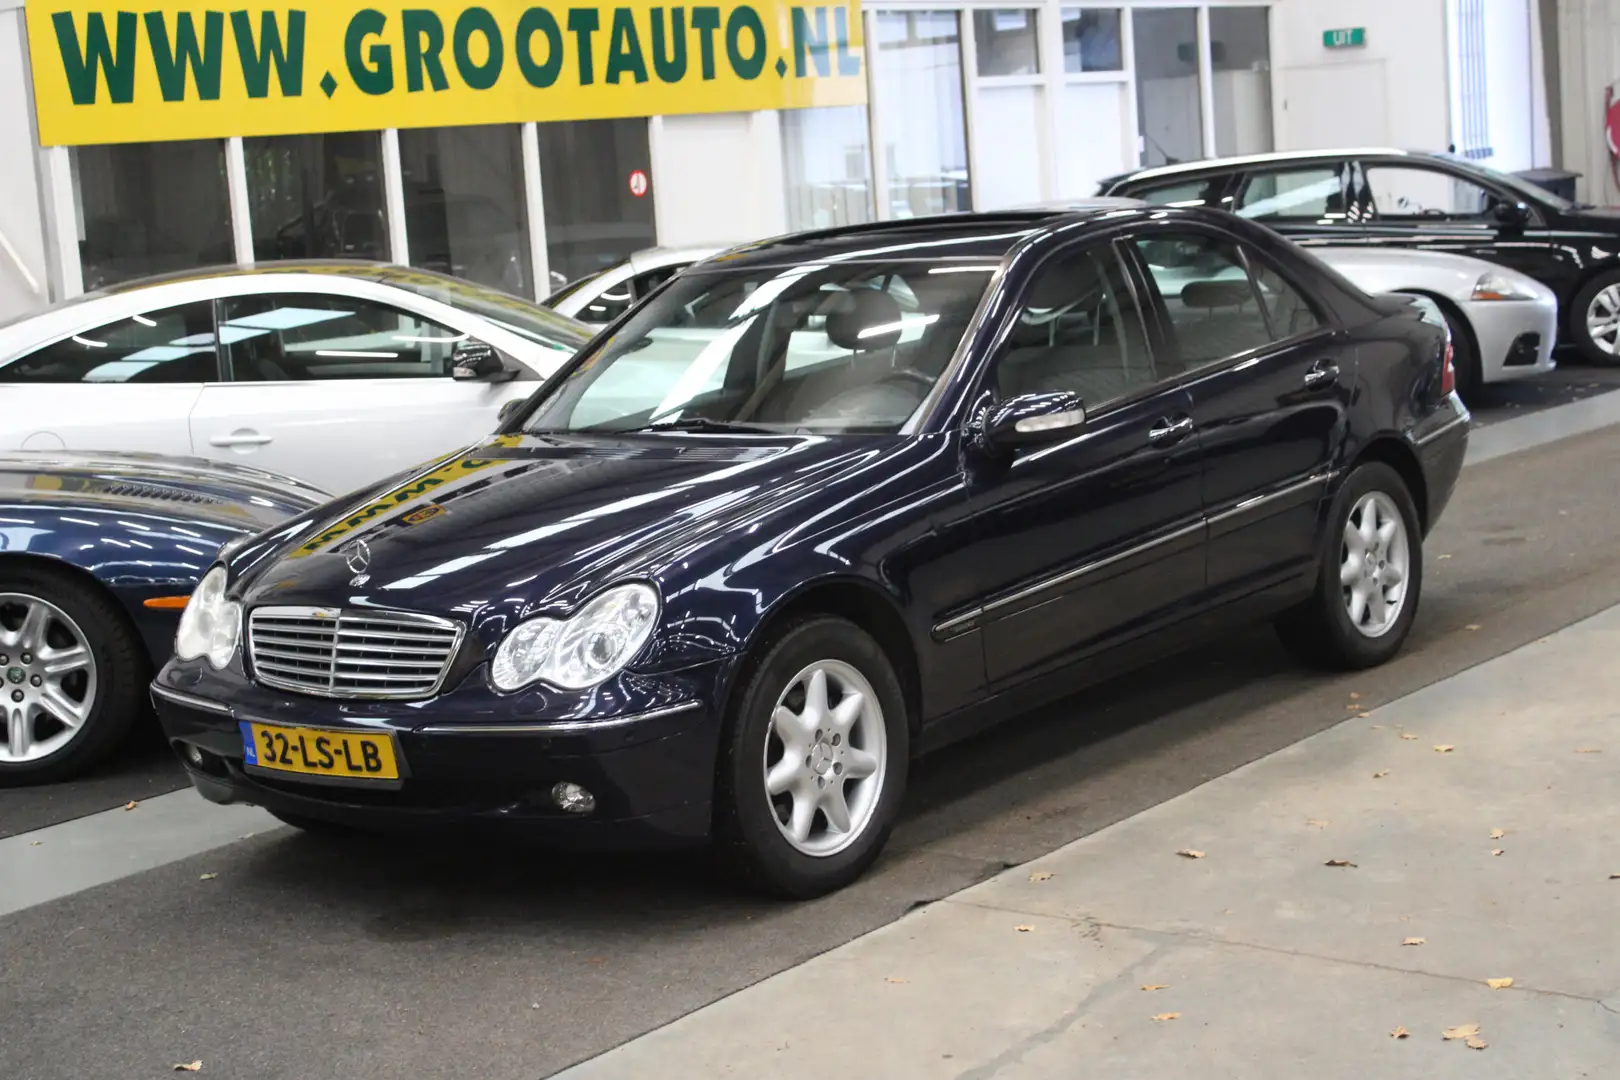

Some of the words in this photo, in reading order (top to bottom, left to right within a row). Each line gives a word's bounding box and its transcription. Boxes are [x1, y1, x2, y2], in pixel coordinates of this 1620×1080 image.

[1332, 30, 1353, 46] UIT
[51, 5, 861, 106] WWW.GROOTAUTO.NL
[246, 746, 256, 758] NL
[261, 730, 382, 773] 32-LS-LB
